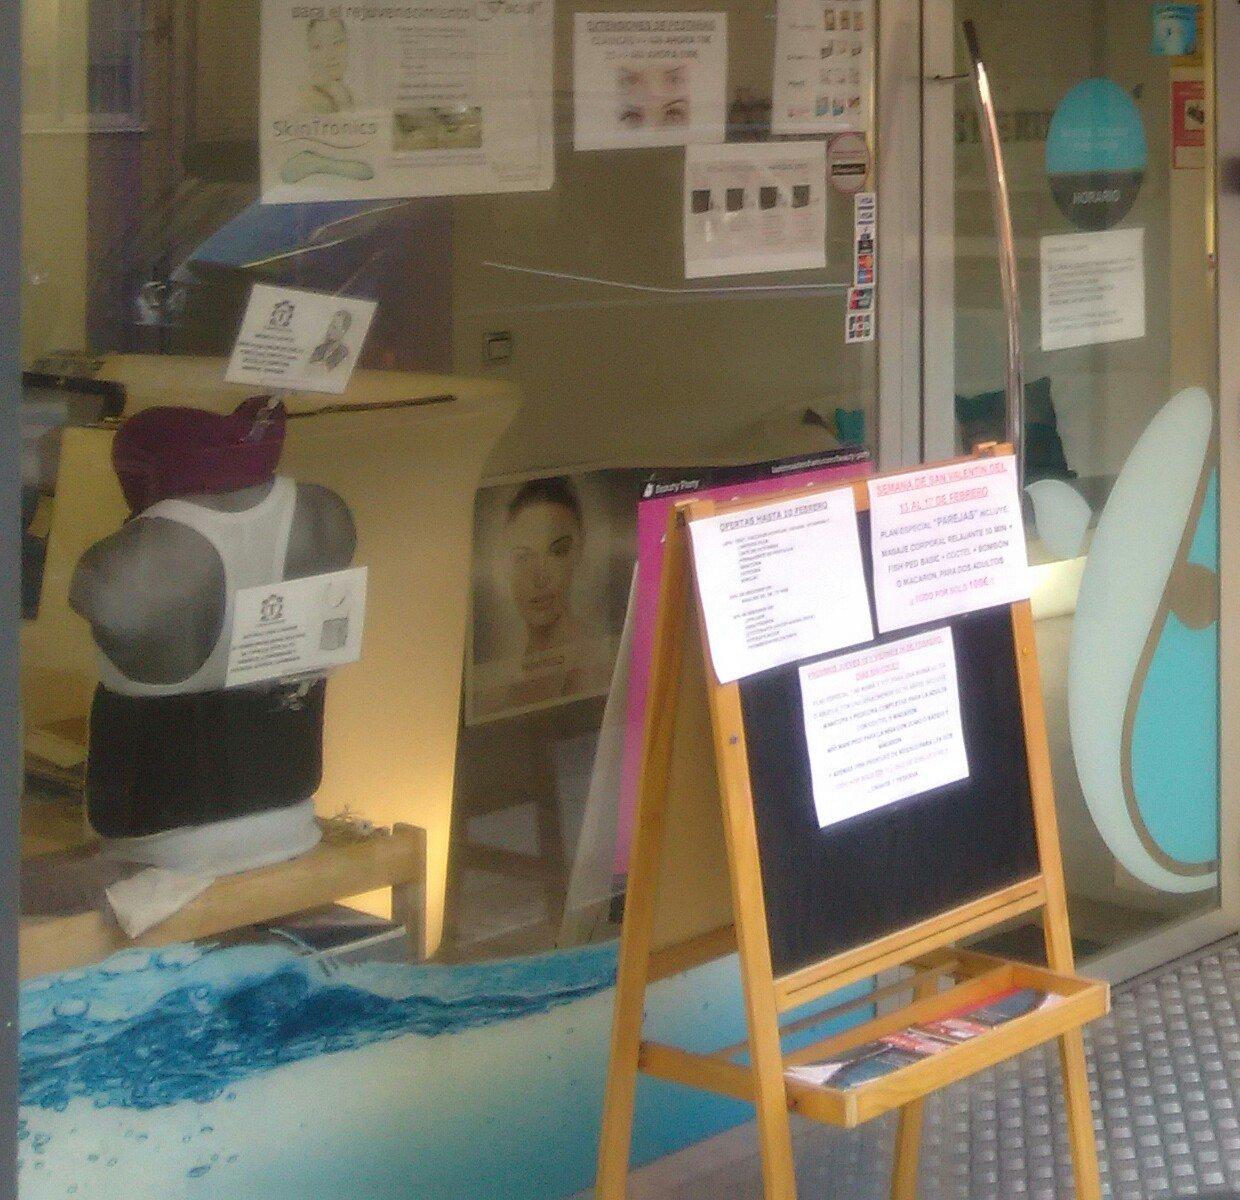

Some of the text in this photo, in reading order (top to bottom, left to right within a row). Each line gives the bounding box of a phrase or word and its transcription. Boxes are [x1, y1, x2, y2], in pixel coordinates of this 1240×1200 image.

[876, 478, 912, 496] SEMANA
[914, 476, 926, 489] DE
[928, 472, 946, 485] SAN
[935, 494, 947, 506] DE
[949, 486, 988, 503] FEBRERO
[719, 516, 754, 532] OFERTAS
[755, 510, 782, 524] HASTA
[794, 500, 828, 516] FEBRERO
